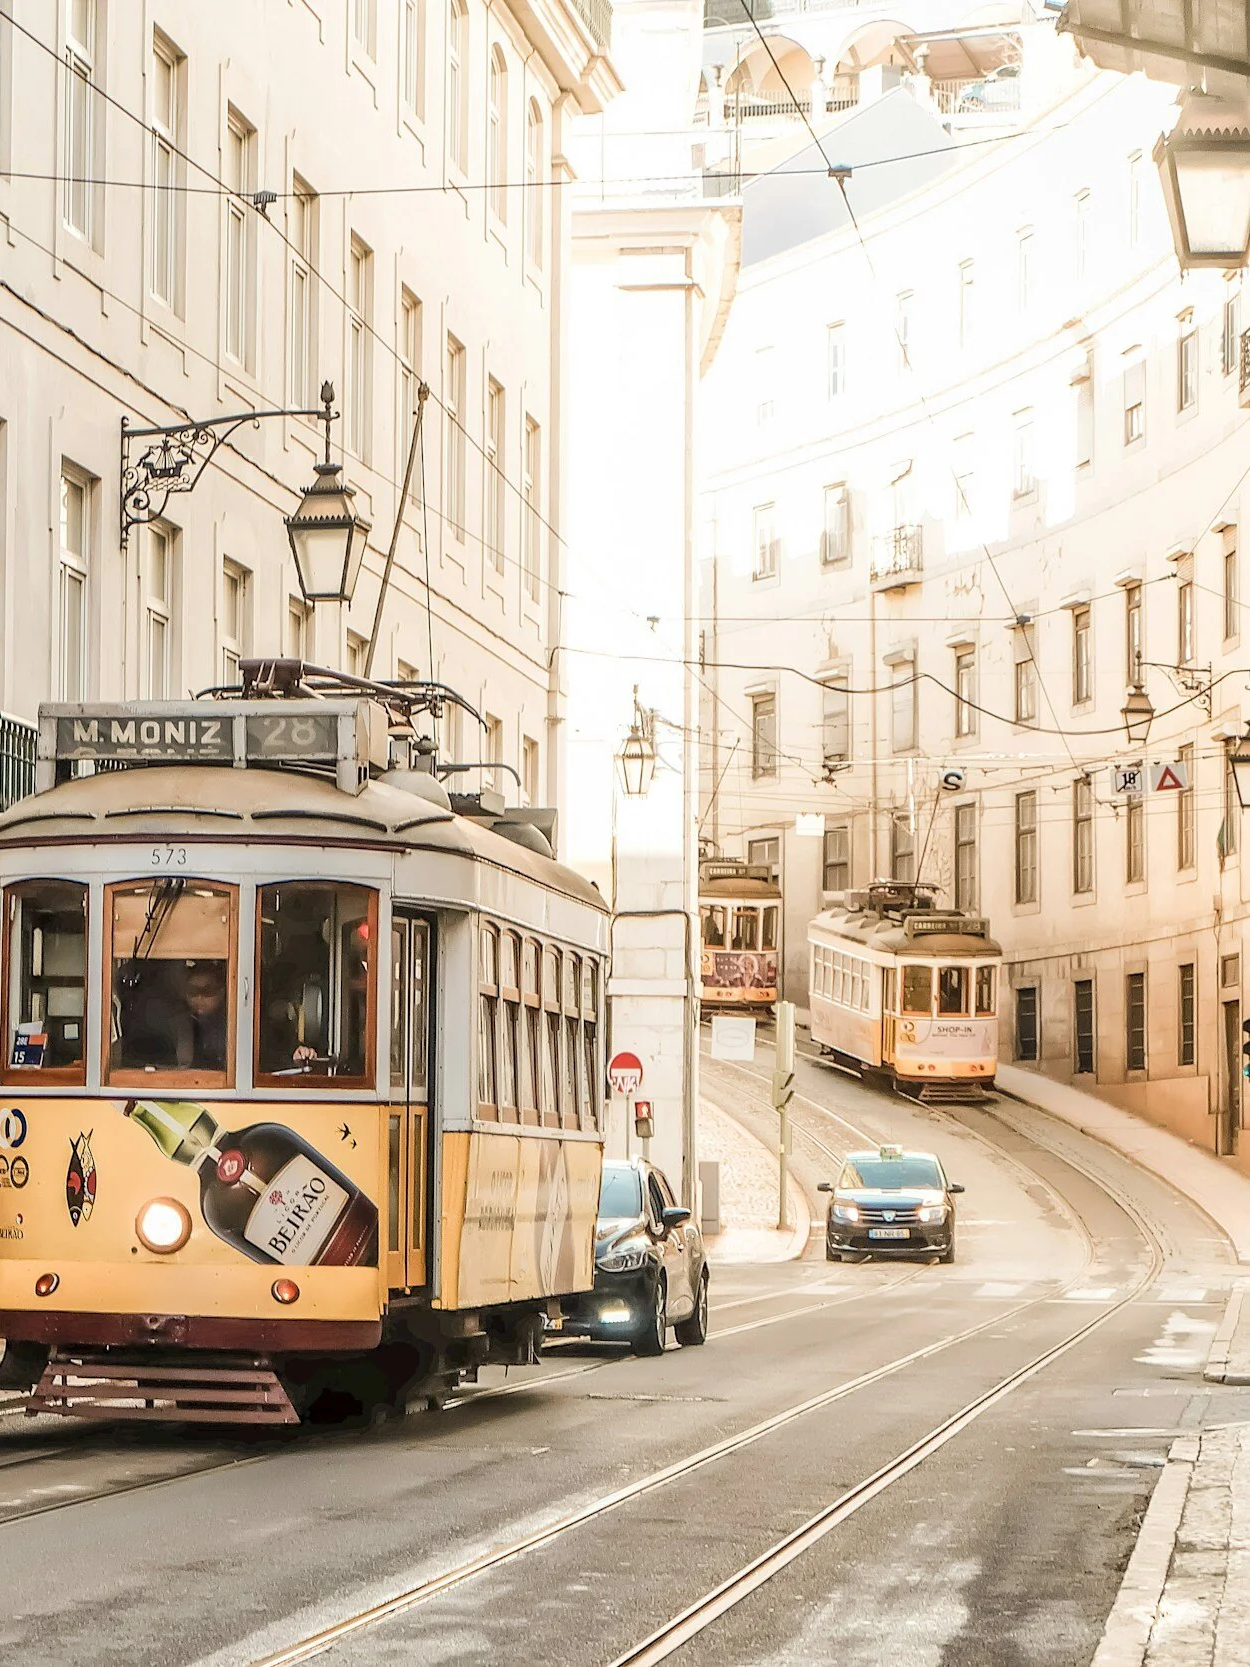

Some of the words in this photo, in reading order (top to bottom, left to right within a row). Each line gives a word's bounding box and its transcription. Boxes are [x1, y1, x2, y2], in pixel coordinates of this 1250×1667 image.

[264, 716, 317, 746] 28
[942, 772, 963, 791] S
[151, 848, 187, 865] 573
[14, 1051, 26, 1064] 15
[268, 1177, 326, 1255] BEIRÃO
